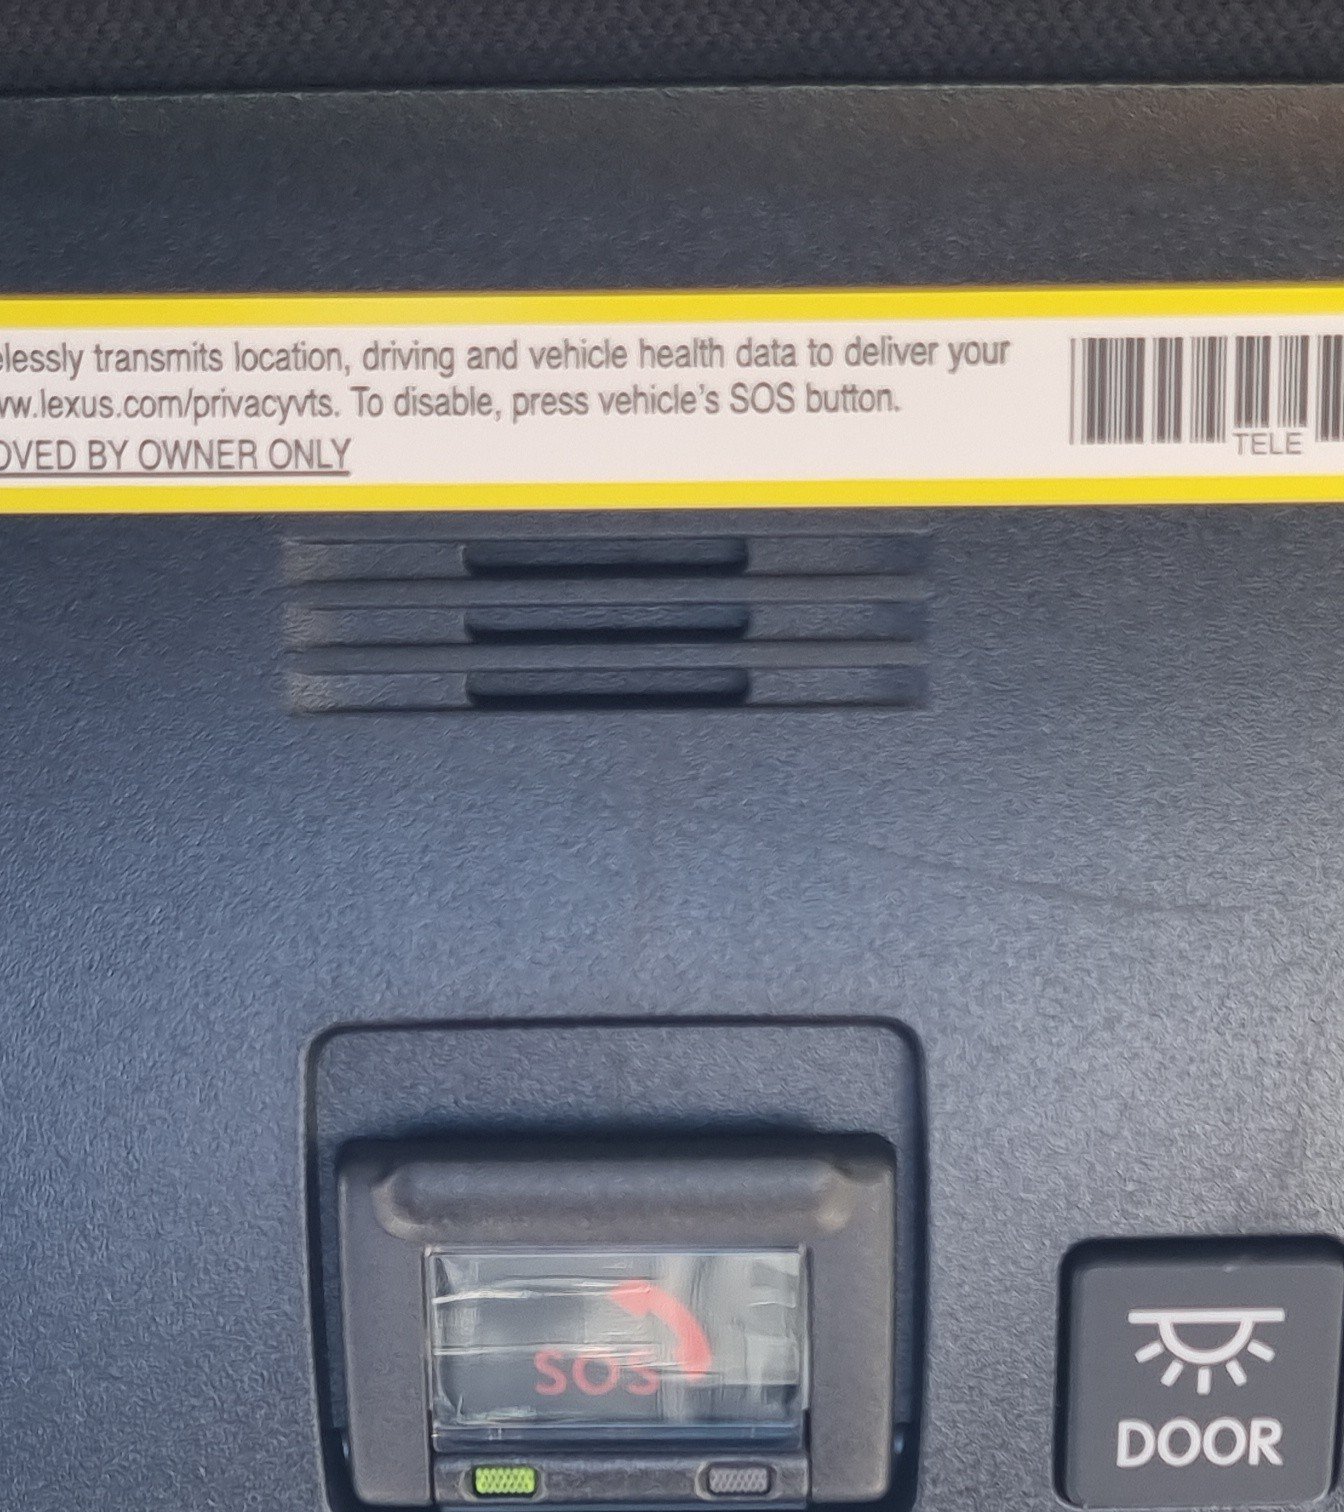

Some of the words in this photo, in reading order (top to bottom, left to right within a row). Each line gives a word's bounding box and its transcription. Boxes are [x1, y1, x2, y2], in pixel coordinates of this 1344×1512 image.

[93, 341, 223, 373] transmits
[234, 340, 351, 378] location,
[362, 338, 455, 379] driving
[467, 338, 518, 371] and
[529, 337, 628, 370] vehicle
[639, 336, 725, 369] health
[736, 336, 799, 368] data
[807, 337, 835, 368] to
[844, 334, 940, 367] deliver
[948, 340, 1011, 376] your
[350, 386, 385, 418] To
[393, 385, 502, 422] disable,
[512, 391, 589, 424] press
[729, 381, 796, 415] SOS
[806, 381, 901, 414] button.
[87, 440, 131, 473] BY
[138, 439, 258, 472] OWNER
[269, 438, 352, 472] ONLY
[1232, 430, 1303, 456] TELE
[533, 1348, 659, 1396] SOS
[1116, 1416, 1284, 1468] DOOR
